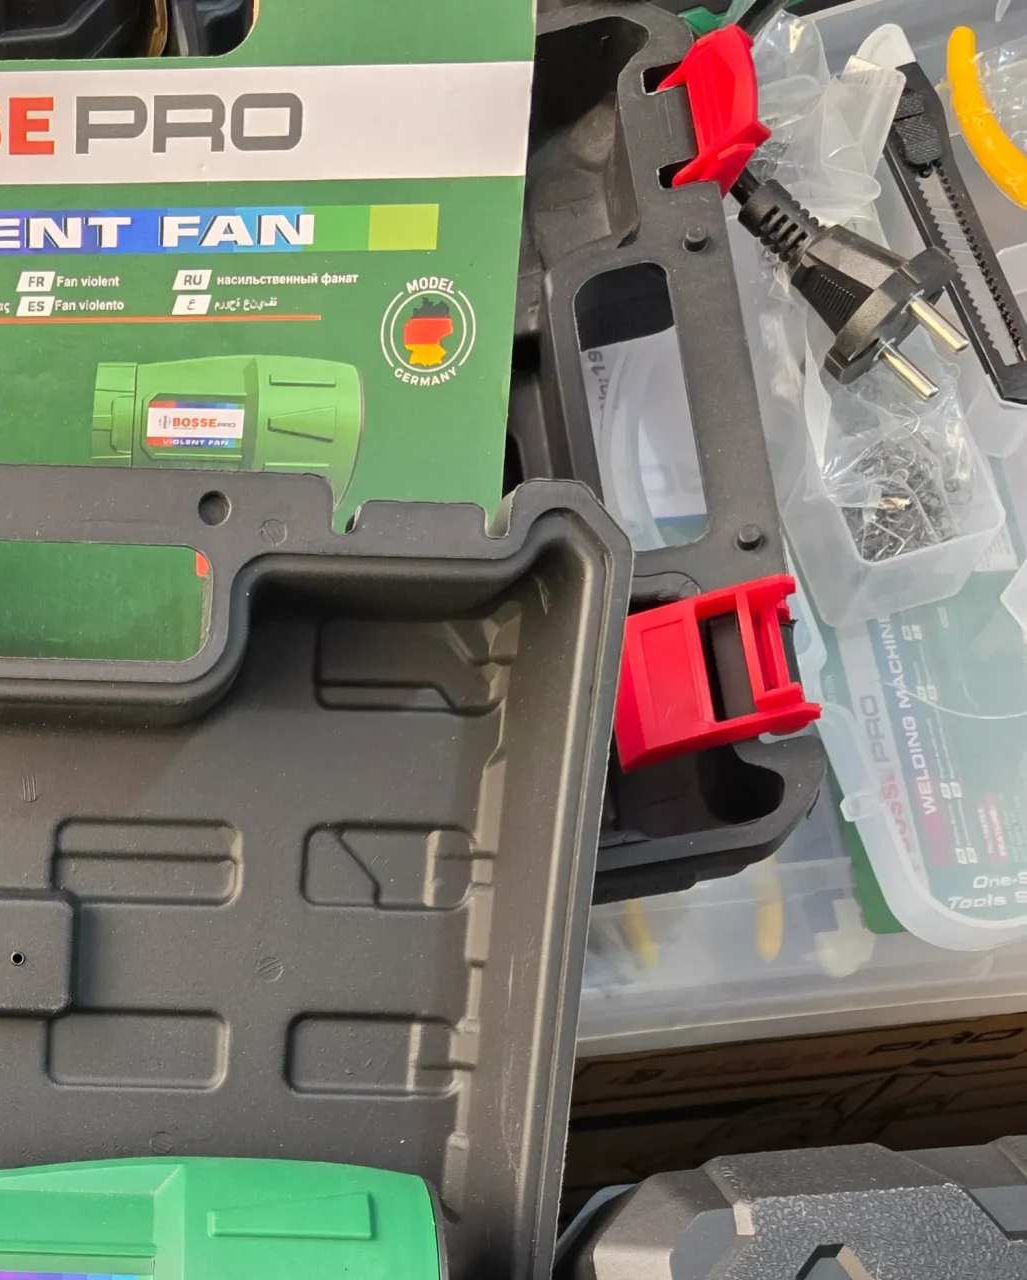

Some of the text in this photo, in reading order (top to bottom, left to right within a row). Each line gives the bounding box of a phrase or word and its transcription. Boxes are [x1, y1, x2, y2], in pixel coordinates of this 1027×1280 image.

[76, 92, 304, 154] PRO
[160, 214, 315, 248] FAN
[28, 275, 120, 287] FR Fan violent
[184, 275, 202, 286] RU
[217, 272, 359, 286] насильственный фанат
[406, 277, 455, 294] MODEL
[28, 299, 125, 312] ES Fan violento
[394, 366, 457, 386] GERMANY
[172, 417, 217, 428] BOSSE
[860, 695, 891, 763] PRO
[902, 715, 937, 816] WELDING
[949, 893, 1006, 910] Tools
